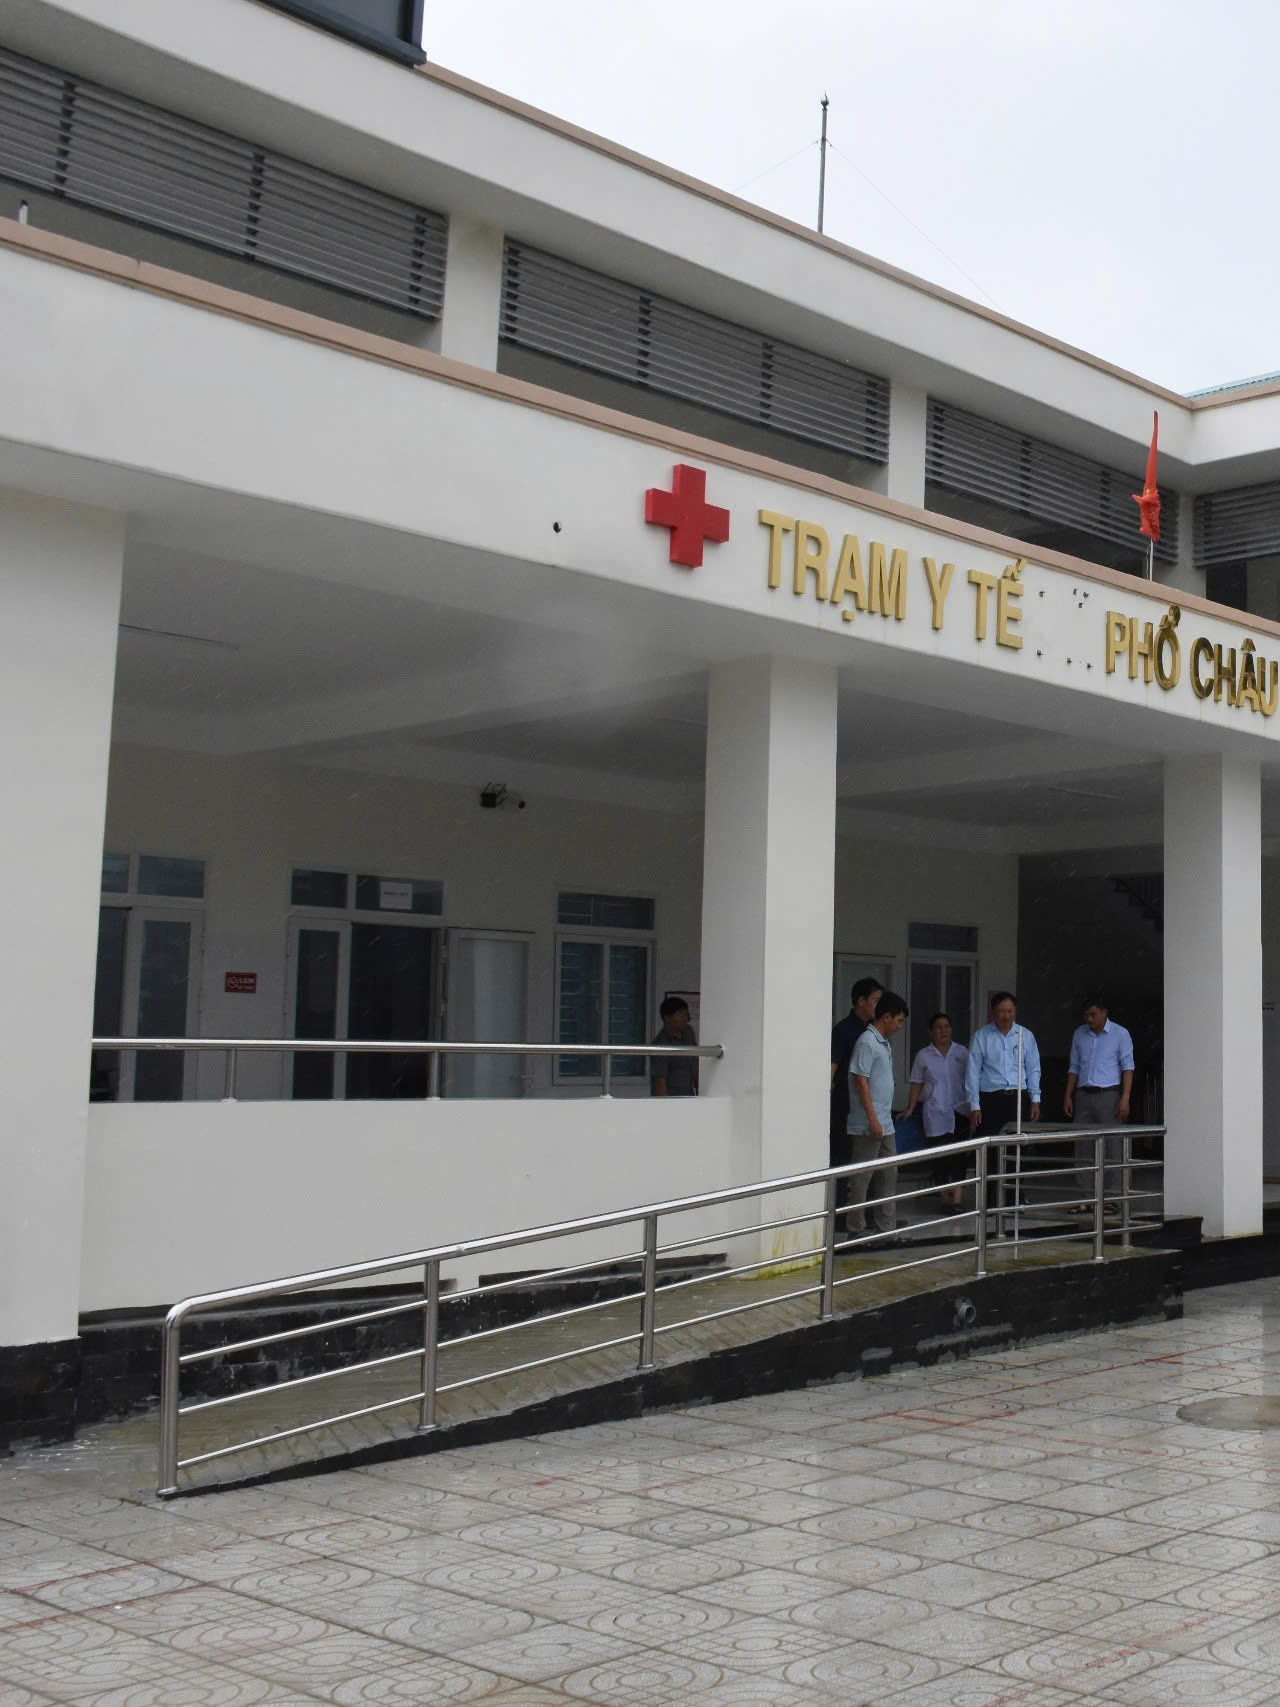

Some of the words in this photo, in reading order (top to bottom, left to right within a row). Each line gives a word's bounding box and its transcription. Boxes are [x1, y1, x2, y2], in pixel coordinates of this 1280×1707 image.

[758, 508, 909, 622] TRẠM
[922, 556, 956, 631] Y
[967, 558, 1028, 650] TẾ
[1105, 604, 1182, 691] PHỔ
[1190, 637, 1279, 717] CHÂU
